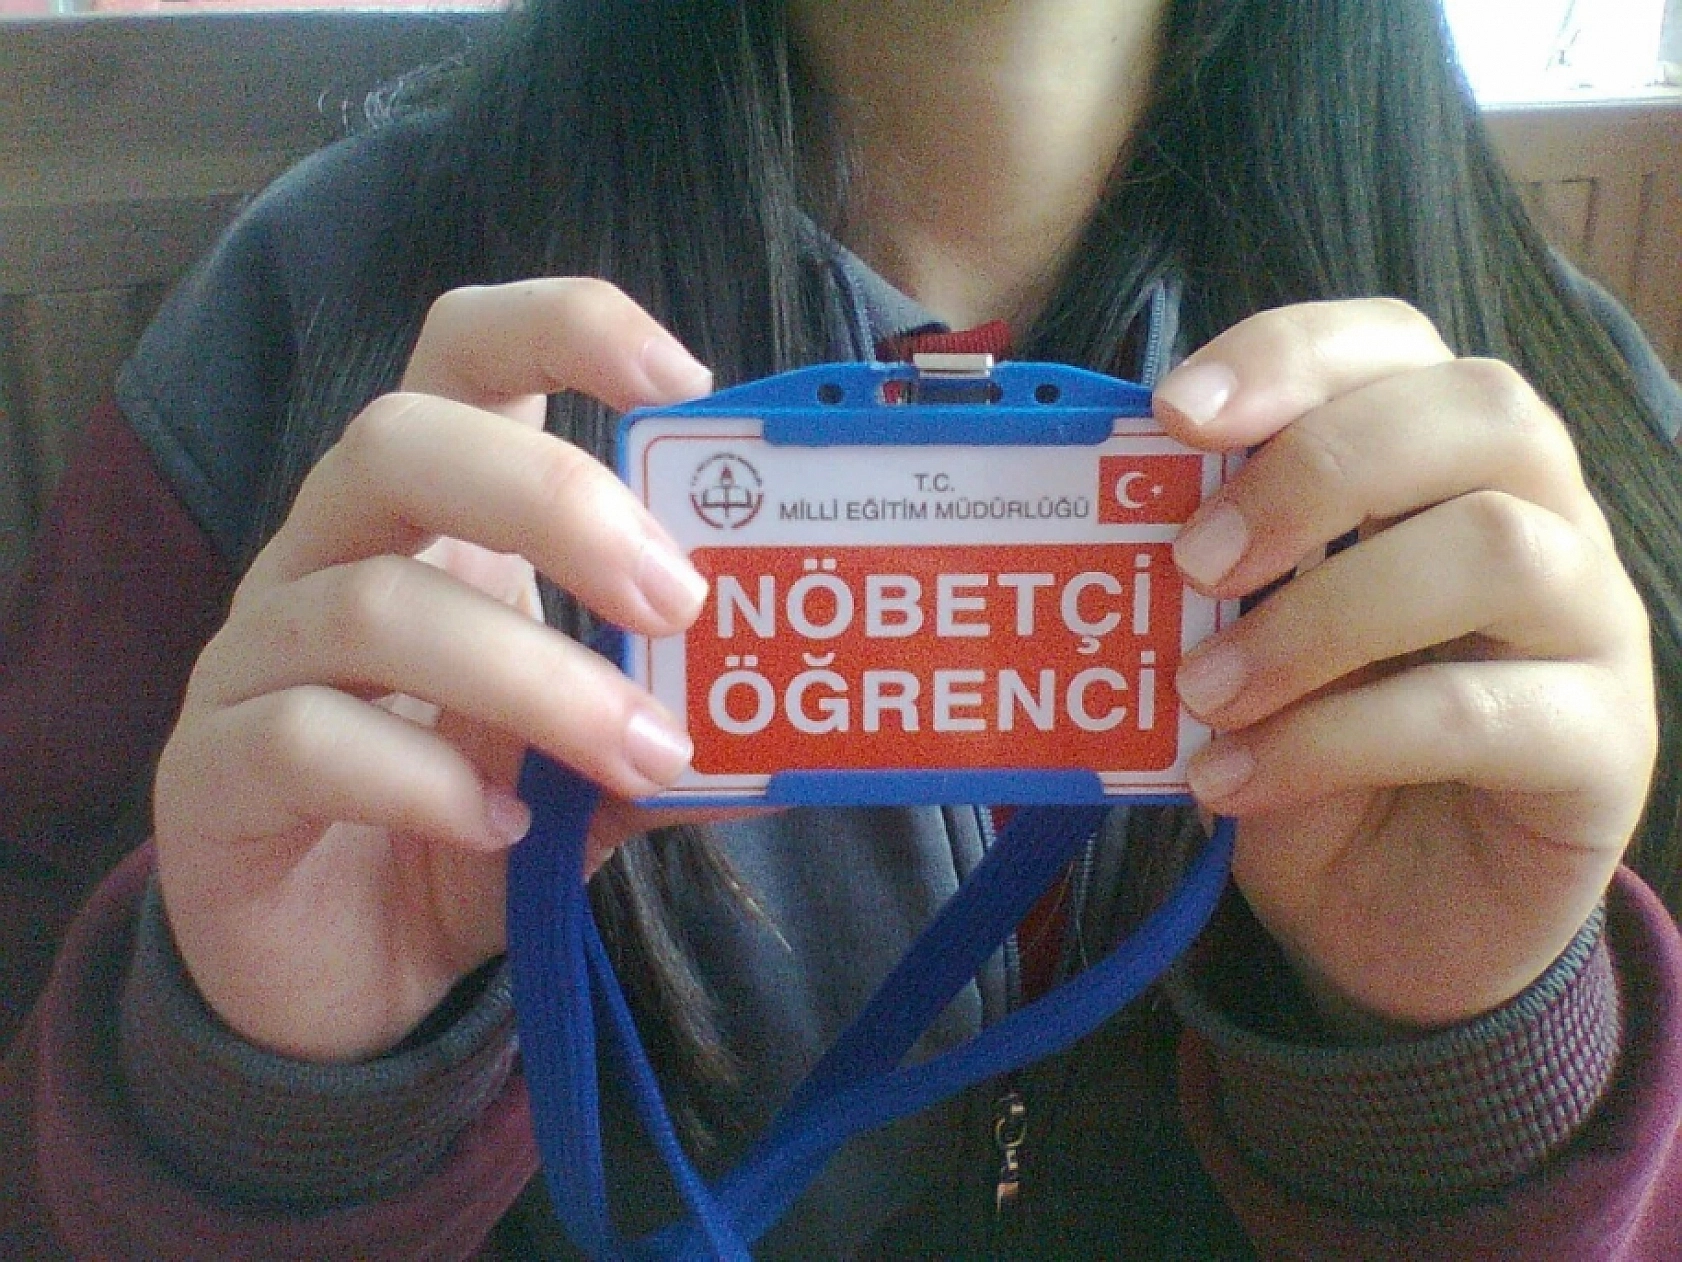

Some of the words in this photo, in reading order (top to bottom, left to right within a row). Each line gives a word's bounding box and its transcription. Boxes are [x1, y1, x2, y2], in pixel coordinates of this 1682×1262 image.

[779, 498, 838, 520] MİLLİ
[846, 497, 928, 520] EĞİTİM
[934, 496, 1089, 520] MÜDÜRLÜĞÜ
[914, 473, 955, 492] T.C.
[716, 553, 1152, 655] NÖBETÇİ
[707, 650, 1156, 735] ÖĞRENCİ
